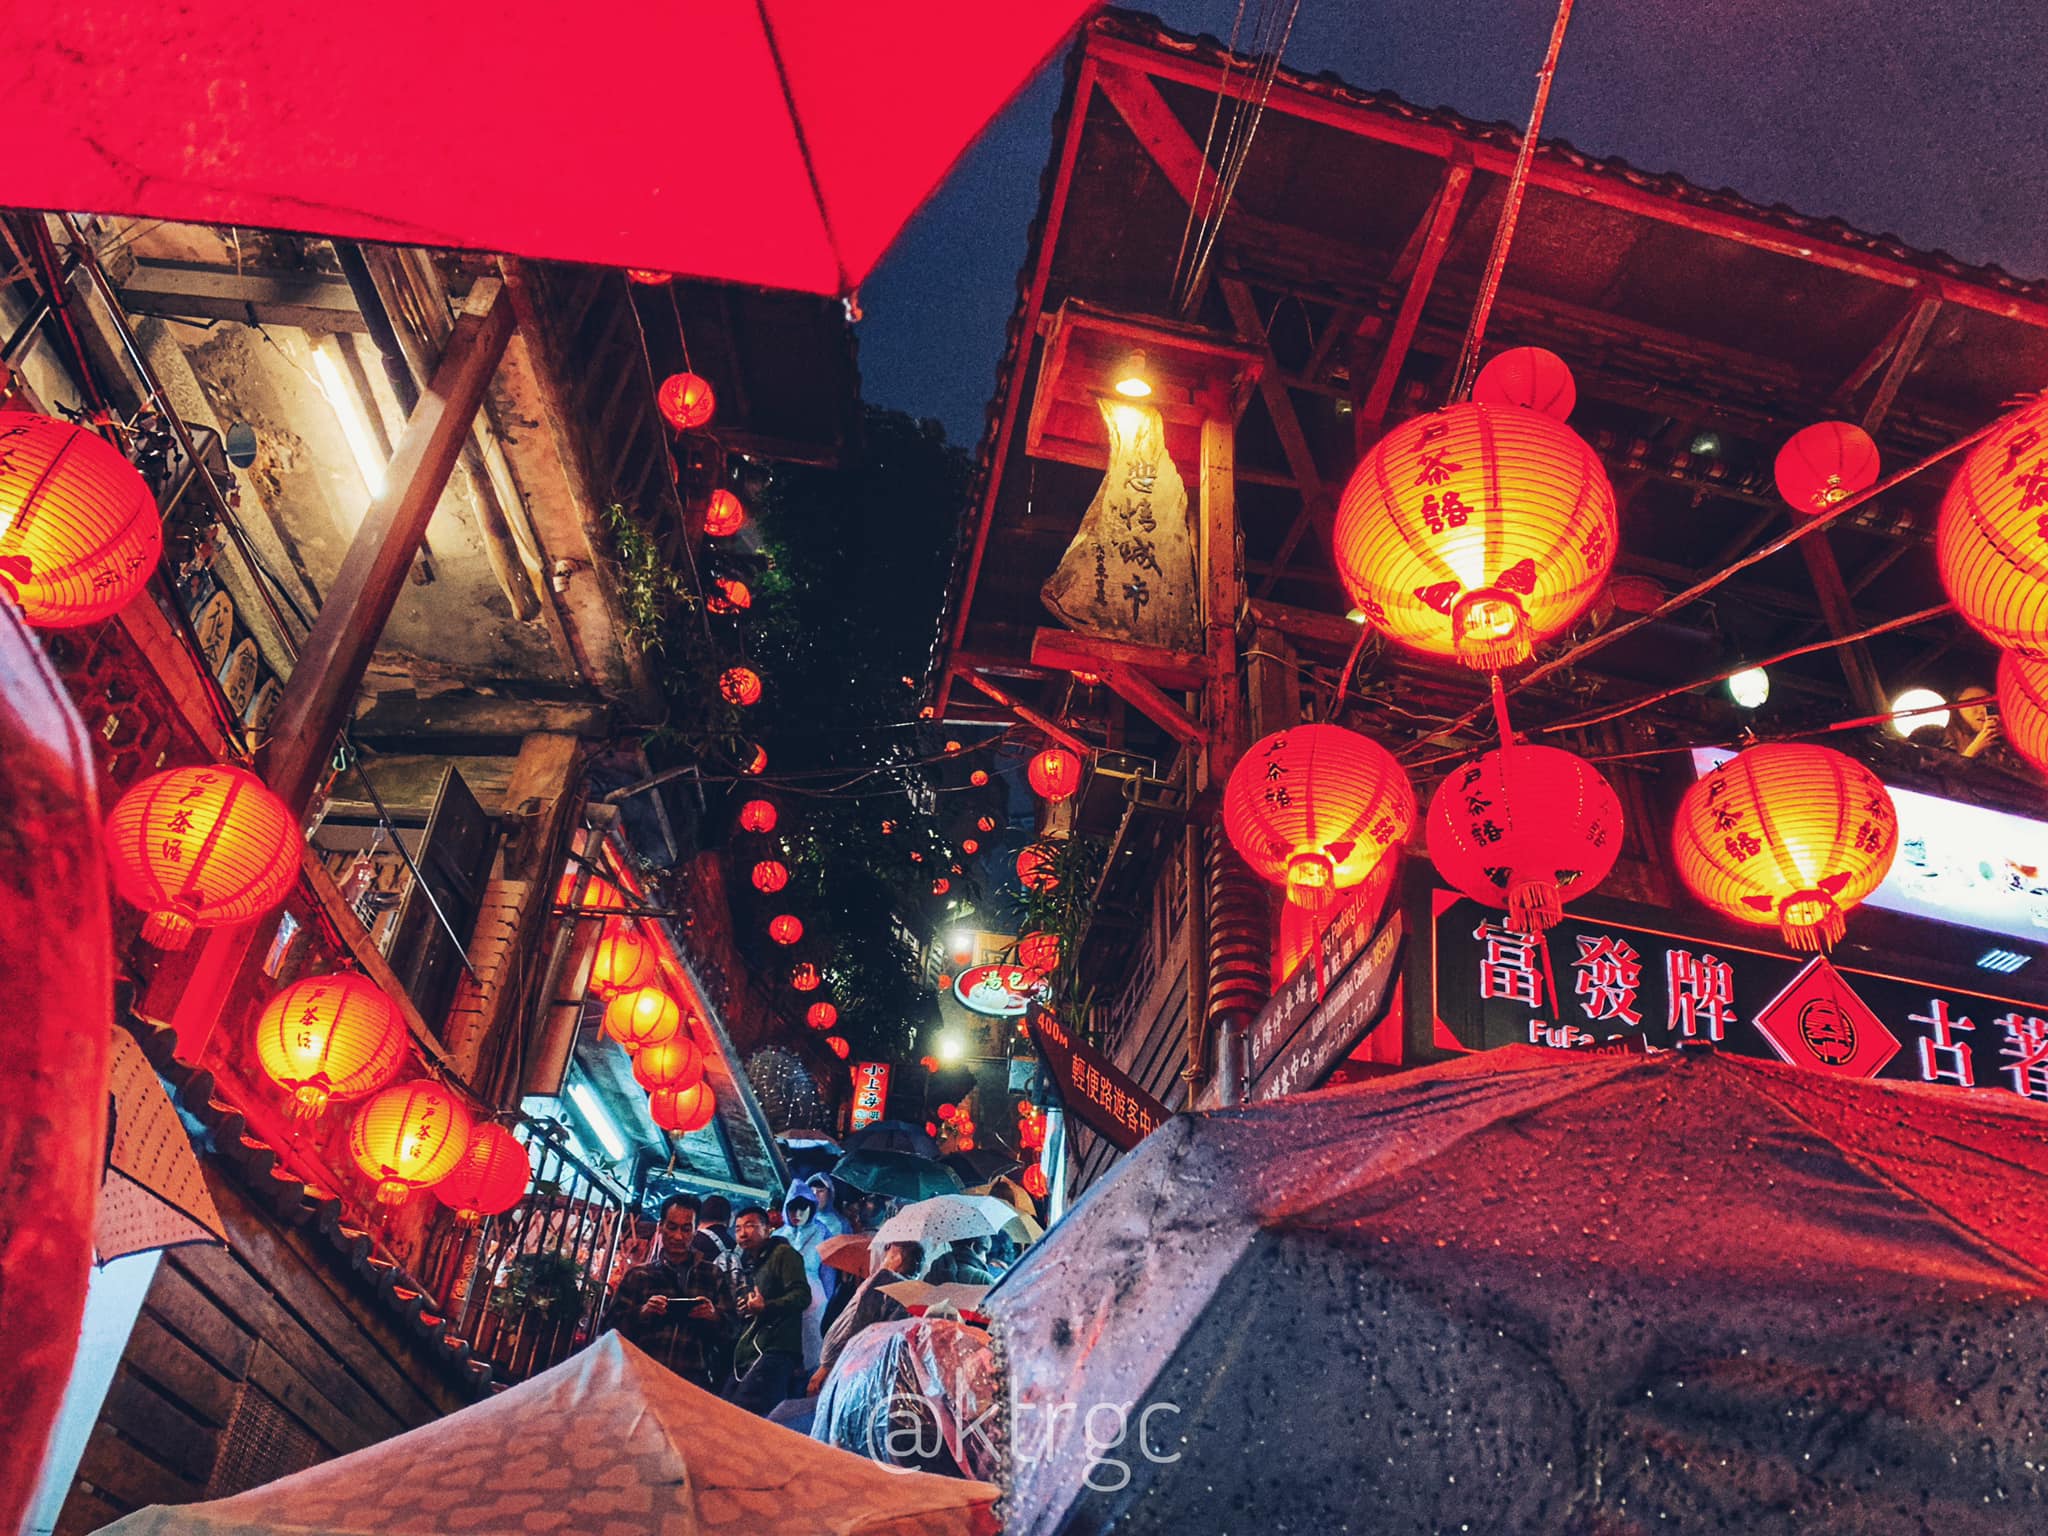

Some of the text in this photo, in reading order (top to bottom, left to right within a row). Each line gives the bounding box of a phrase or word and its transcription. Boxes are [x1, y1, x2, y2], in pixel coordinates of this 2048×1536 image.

[1473, 917, 1738, 1042] 富發牌
[1037, 1012, 1069, 1049] 400M
